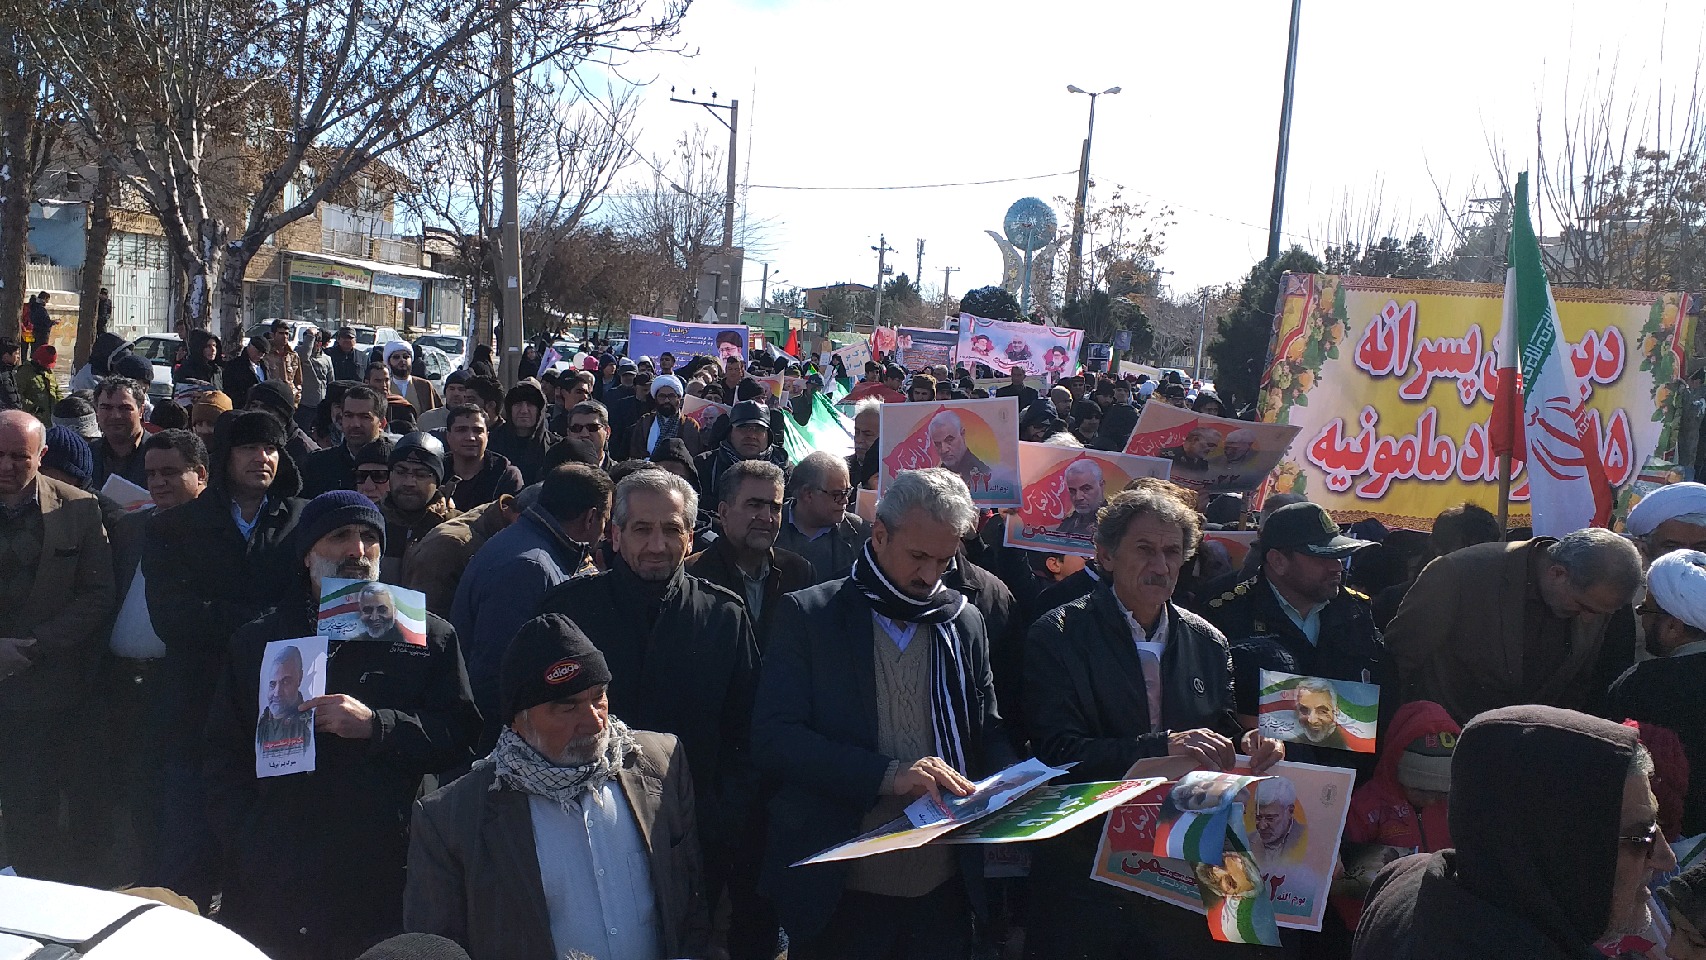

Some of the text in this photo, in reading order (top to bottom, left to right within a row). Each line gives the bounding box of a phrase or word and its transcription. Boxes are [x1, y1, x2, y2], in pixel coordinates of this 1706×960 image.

[1356, 301, 1482, 404] پسرانه
[1308, 406, 1456, 498] مامونیه
[971, 472, 991, 493] ۲۲
[1276, 891, 1306, 906] یوم الله
